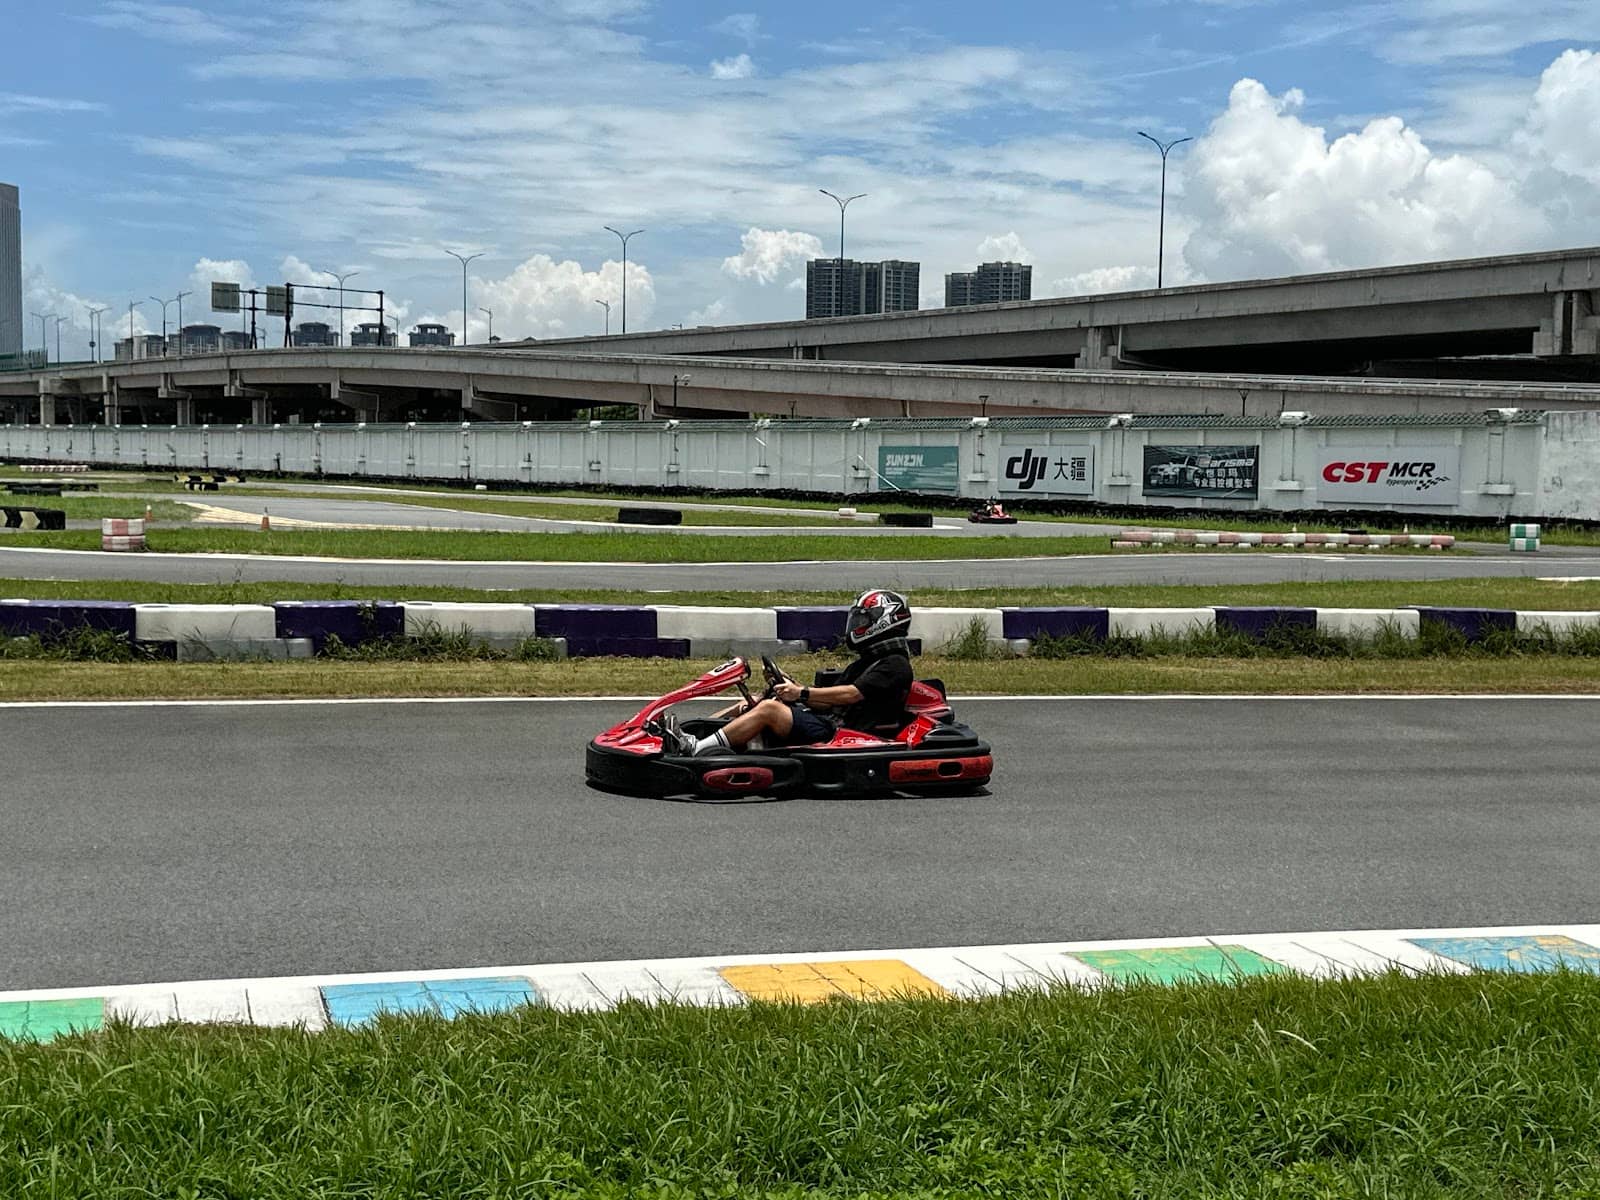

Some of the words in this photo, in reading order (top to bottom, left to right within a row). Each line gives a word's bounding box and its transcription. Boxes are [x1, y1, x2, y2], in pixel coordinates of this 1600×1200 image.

[1054, 457, 1086, 481] 大疆
[1322, 462, 1389, 483] CST
[1389, 462, 1436, 477] MCR
